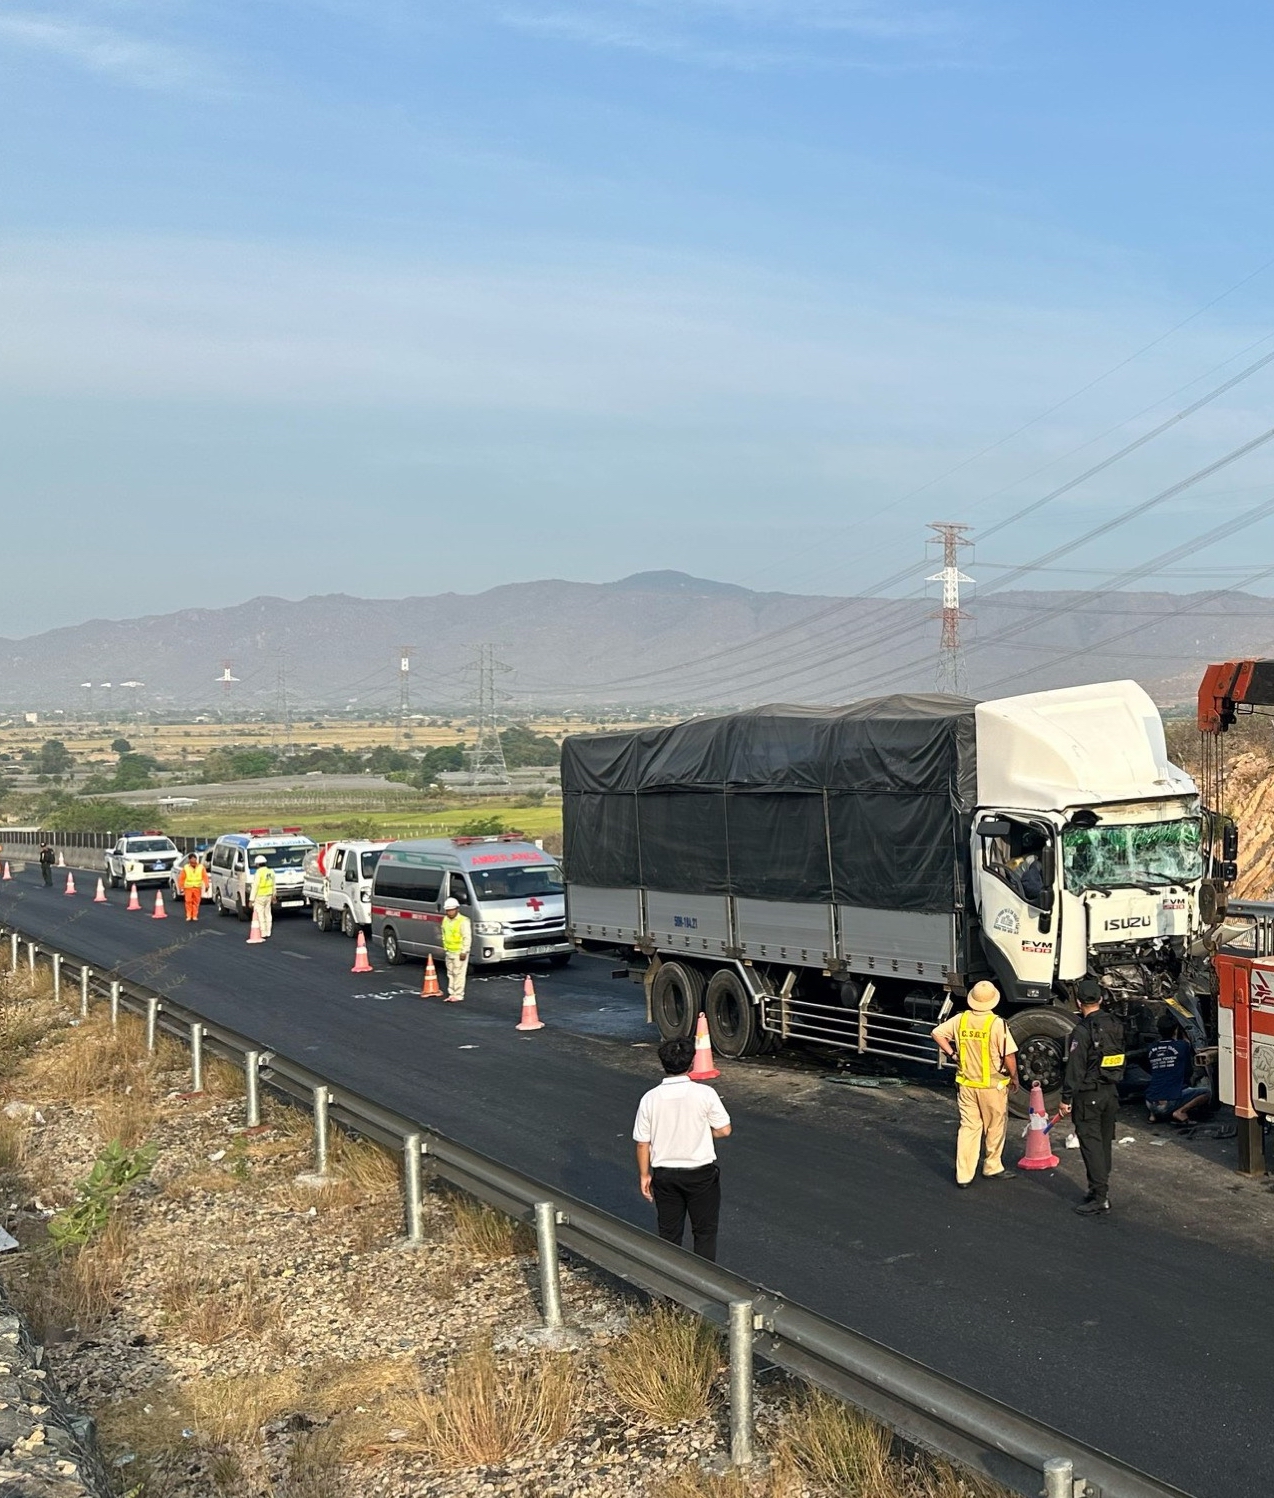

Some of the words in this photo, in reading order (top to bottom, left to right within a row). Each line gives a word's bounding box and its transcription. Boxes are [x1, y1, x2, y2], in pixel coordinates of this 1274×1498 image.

[472, 852, 543, 865] AMBULANCE
[1104, 915, 1151, 931] ISUZU
[1021, 940, 1053, 949] FVM
[1021, 946, 1052, 954] 1500
